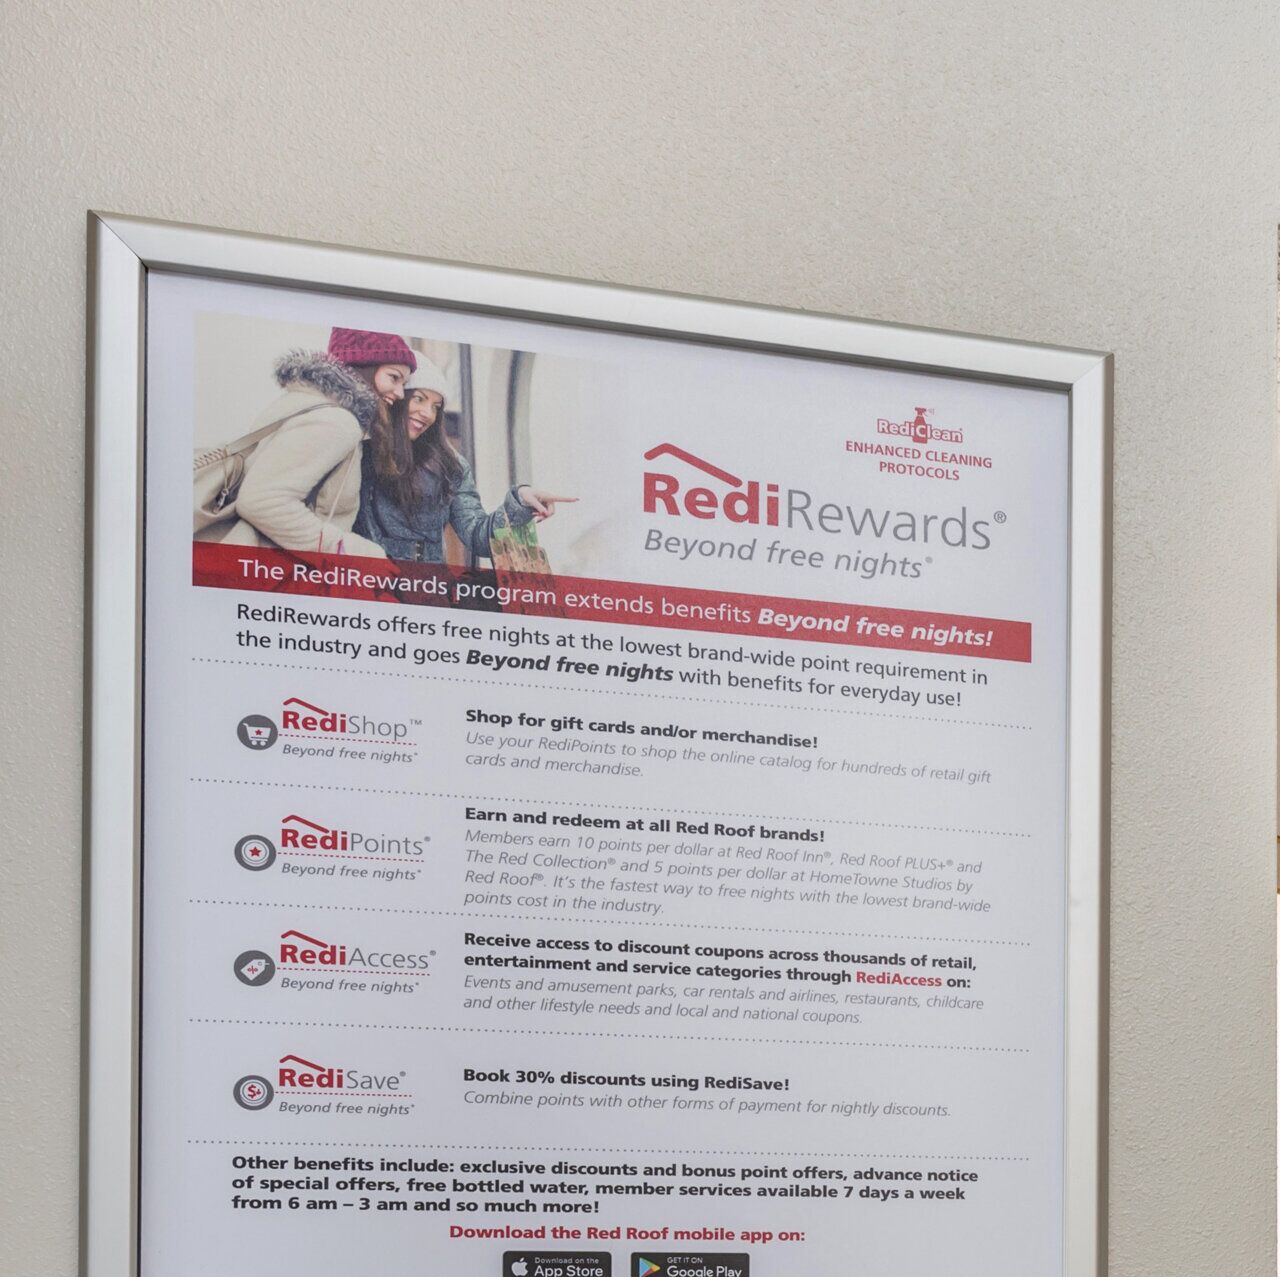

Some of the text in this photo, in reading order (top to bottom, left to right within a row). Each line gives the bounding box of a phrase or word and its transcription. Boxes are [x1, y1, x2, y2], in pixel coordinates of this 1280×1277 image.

[877, 418, 963, 443] RediClean
[846, 440, 992, 469] ENHANCED CLEANING
[880, 460, 959, 481] PROTOCOLS
[644, 528, 757, 561] Beyond
[766, 540, 824, 568] free
[239, 559, 993, 646] The RediRewards program extends benefits Beyond free nights!
[238, 603, 987, 685] RediRewards offers free nights at the lowest brand-wide point requirement in
[236, 629, 960, 707] the industry and goes Beyond free nights with benefits for everyday use!
[466, 709, 817, 748] Shop for gift cards and/or merchandise!
[466, 807, 824, 842] Earn and redeem at all Red Roof brands!
[464, 890, 663, 916] points cost in the industry.
[465, 932, 976, 971] Receive access to discount coupons across thousands of retail,
[464, 1068, 789, 1091] Book 30% discounts using RediSave!
[464, 1090, 950, 1117] Combine points with other forms of payment for nightly discounts.
[232, 1195, 282, 1209] from
[289, 1196, 300, 1209] 6
[306, 1199, 337, 1210] am
[360, 1197, 370, 1210] 3
[377, 1200, 407, 1211] am
[414, 1197, 450, 1211] and
[457, 1201, 478, 1212] so
[485, 1198, 537, 1212] much
[543, 1200, 599, 1213] more!
[450, 1225, 805, 1244] Download the Red Roof mobile app on:
[567, 1265, 603, 1276] Store
